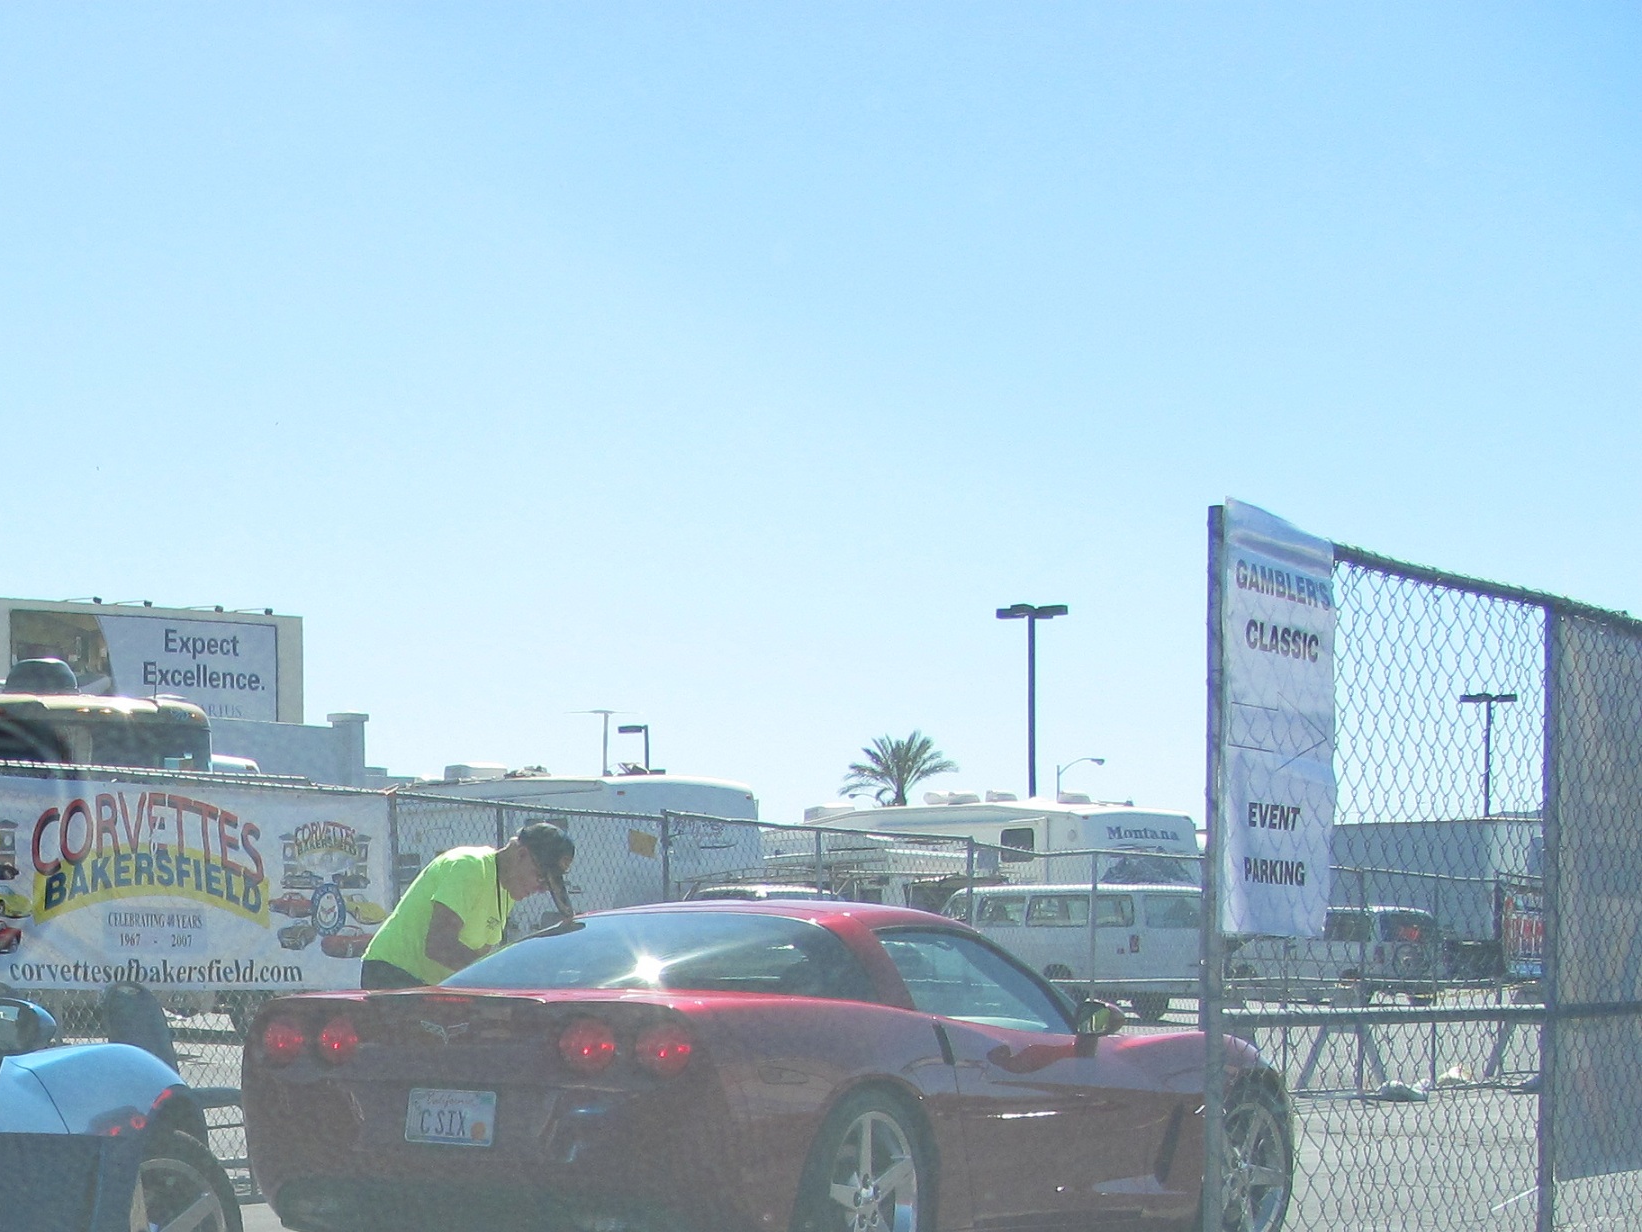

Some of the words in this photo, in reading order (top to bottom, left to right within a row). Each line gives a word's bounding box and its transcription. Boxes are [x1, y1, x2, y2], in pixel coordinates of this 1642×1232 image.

[164, 628, 240, 660] Expect
[1245, 619, 1319, 663] CLASSIC
[143, 661, 266, 691] Excellence.
[1248, 802, 1301, 831] EVENT
[32, 792, 265, 877] CORVETTES
[294, 821, 356, 846] CORVETTES
[1106, 826, 1180, 841] Montana
[44, 852, 262, 915] BAKERSFIELD
[1244, 857, 1305, 886] PARKING
[108, 912, 165, 928] CELEBRATING
[176, 914, 203, 928] YEARS
[120, 933, 141, 947] 1967
[171, 934, 193, 947] 2007
[9, 958, 303, 984] corvettesofbakersfield.com
